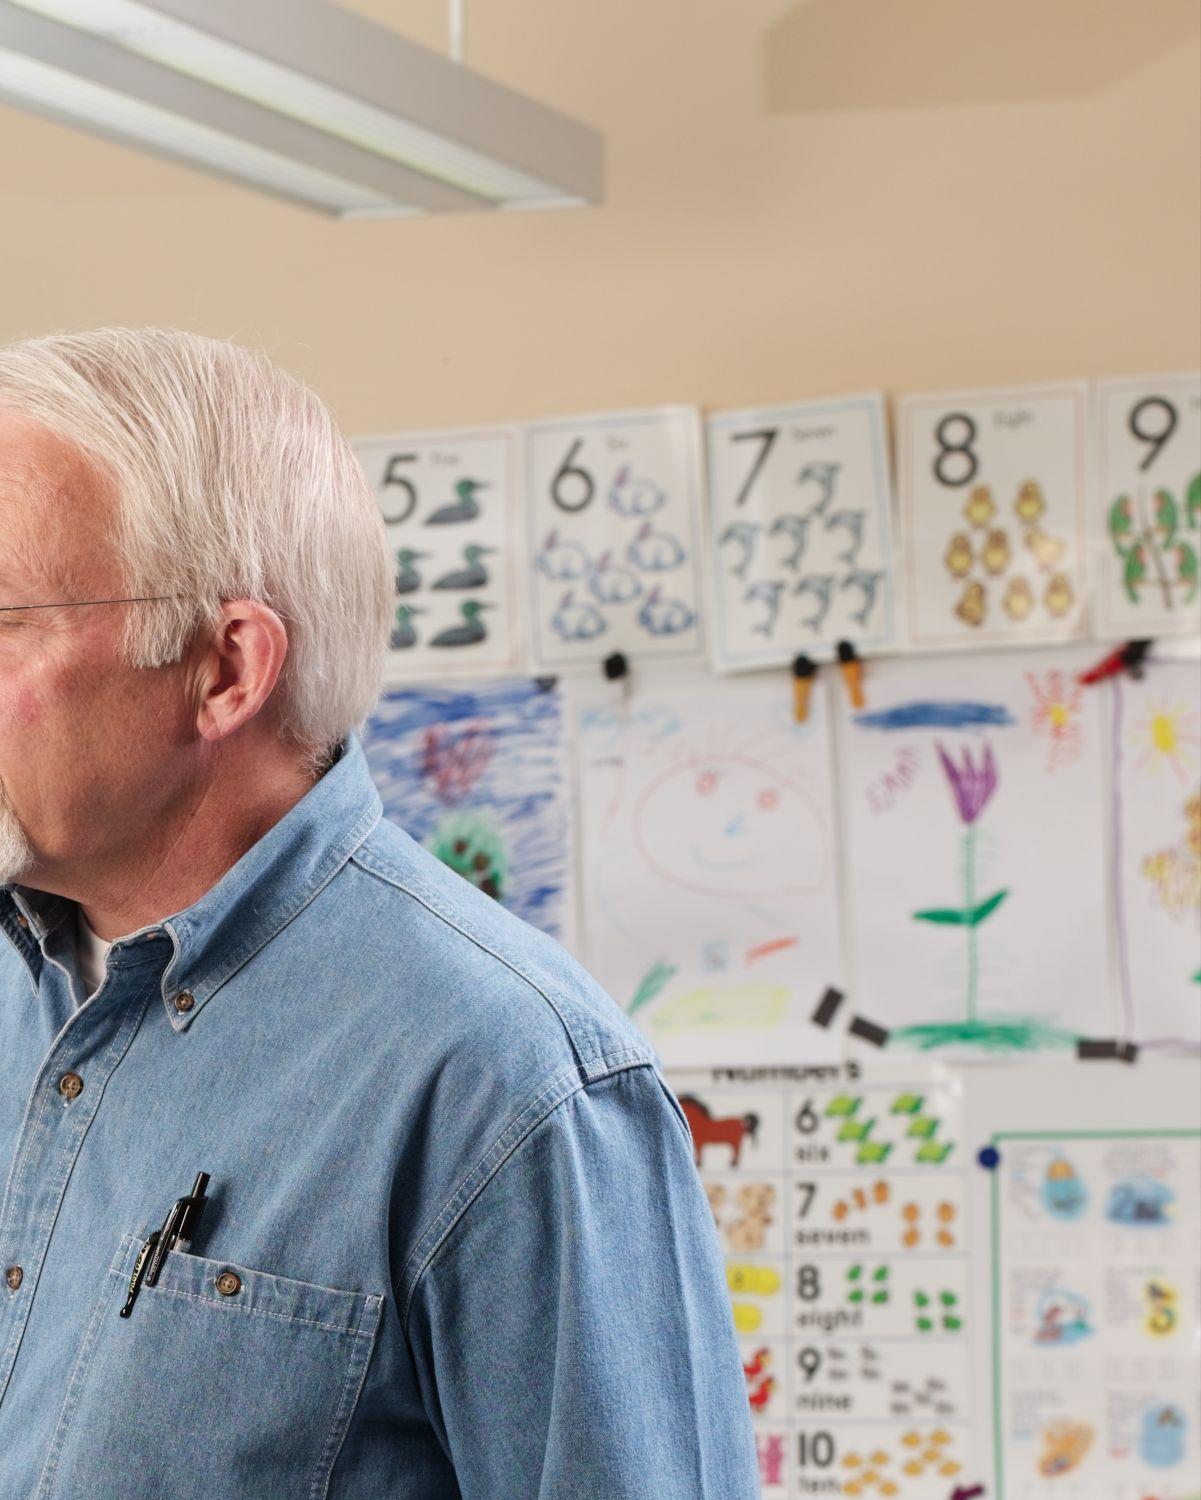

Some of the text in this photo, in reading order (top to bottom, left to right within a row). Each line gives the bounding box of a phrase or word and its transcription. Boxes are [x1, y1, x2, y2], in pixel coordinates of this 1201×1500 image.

[932, 411, 980, 488] 8
[1126, 396, 1179, 473] 9
[380, 453, 421, 526] 5
[550, 437, 595, 513] 6
[729, 426, 780, 509] 7
[795, 1099, 819, 1134] 6
[797, 1183, 817, 1218] 7
[797, 1265, 821, 1302] 8
[797, 1347, 821, 1383] 9
[798, 1431, 835, 1468] 10
